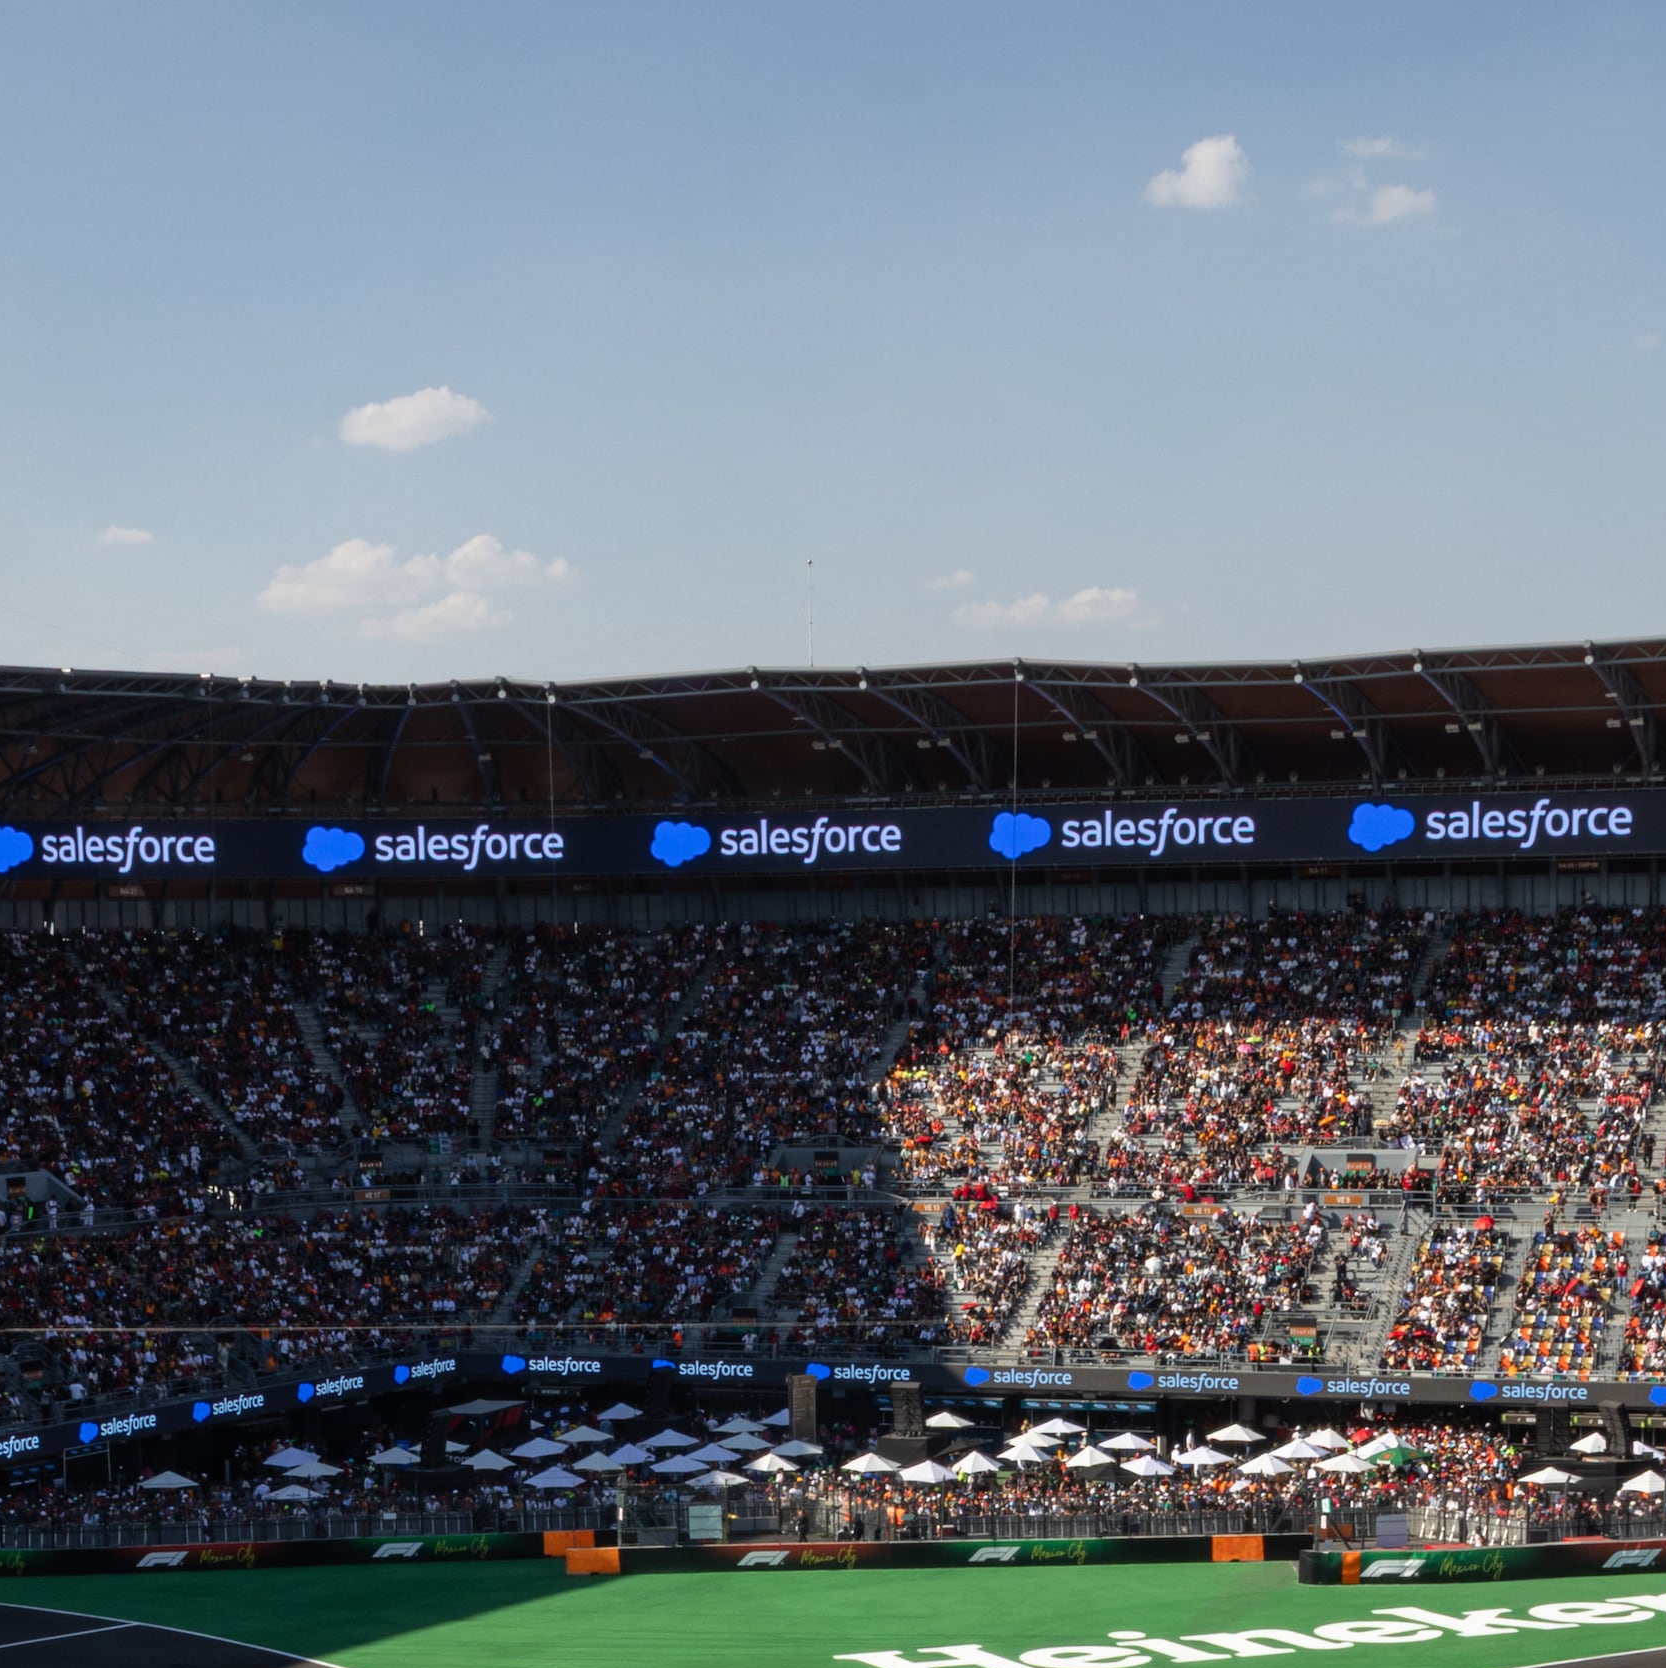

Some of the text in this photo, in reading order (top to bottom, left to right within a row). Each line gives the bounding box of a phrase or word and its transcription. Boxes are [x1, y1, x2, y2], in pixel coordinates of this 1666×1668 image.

[1061, 807, 1255, 856] salesforce
[1426, 799, 1633, 849] salesforce
[42, 827, 215, 872] salesforce
[375, 825, 564, 870] salesforce
[720, 816, 902, 863] salesforce
[411, 1358, 456, 1379] salesforce
[528, 1356, 601, 1376] salesforce
[679, 1359, 753, 1379] salesforce
[833, 1364, 911, 1383] salesforce
[993, 1366, 1073, 1388] salesforce
[315, 1375, 364, 1397] salesforce
[1158, 1373, 1239, 1391] salesforce
[1327, 1378, 1411, 1398] salesforce
[1502, 1382, 1588, 1401] salesforce
[212, 1393, 264, 1416] salesforce
[100, 1413, 157, 1437] salesforce
[199, 1549, 235, 1564] Mexico
[237, 1543, 257, 1569] City
[434, 1539, 468, 1555] Mexico
[470, 1535, 489, 1559] City
[801, 1549, 834, 1565] Mexico
[837, 1544, 858, 1569] City
[1031, 1544, 1065, 1561] Mexico
[1068, 1540, 1087, 1565] City
[7, 1550, 25, 1575] City
[1439, 1556, 1480, 1575] Mexico
[1483, 1550, 1506, 1580] City
